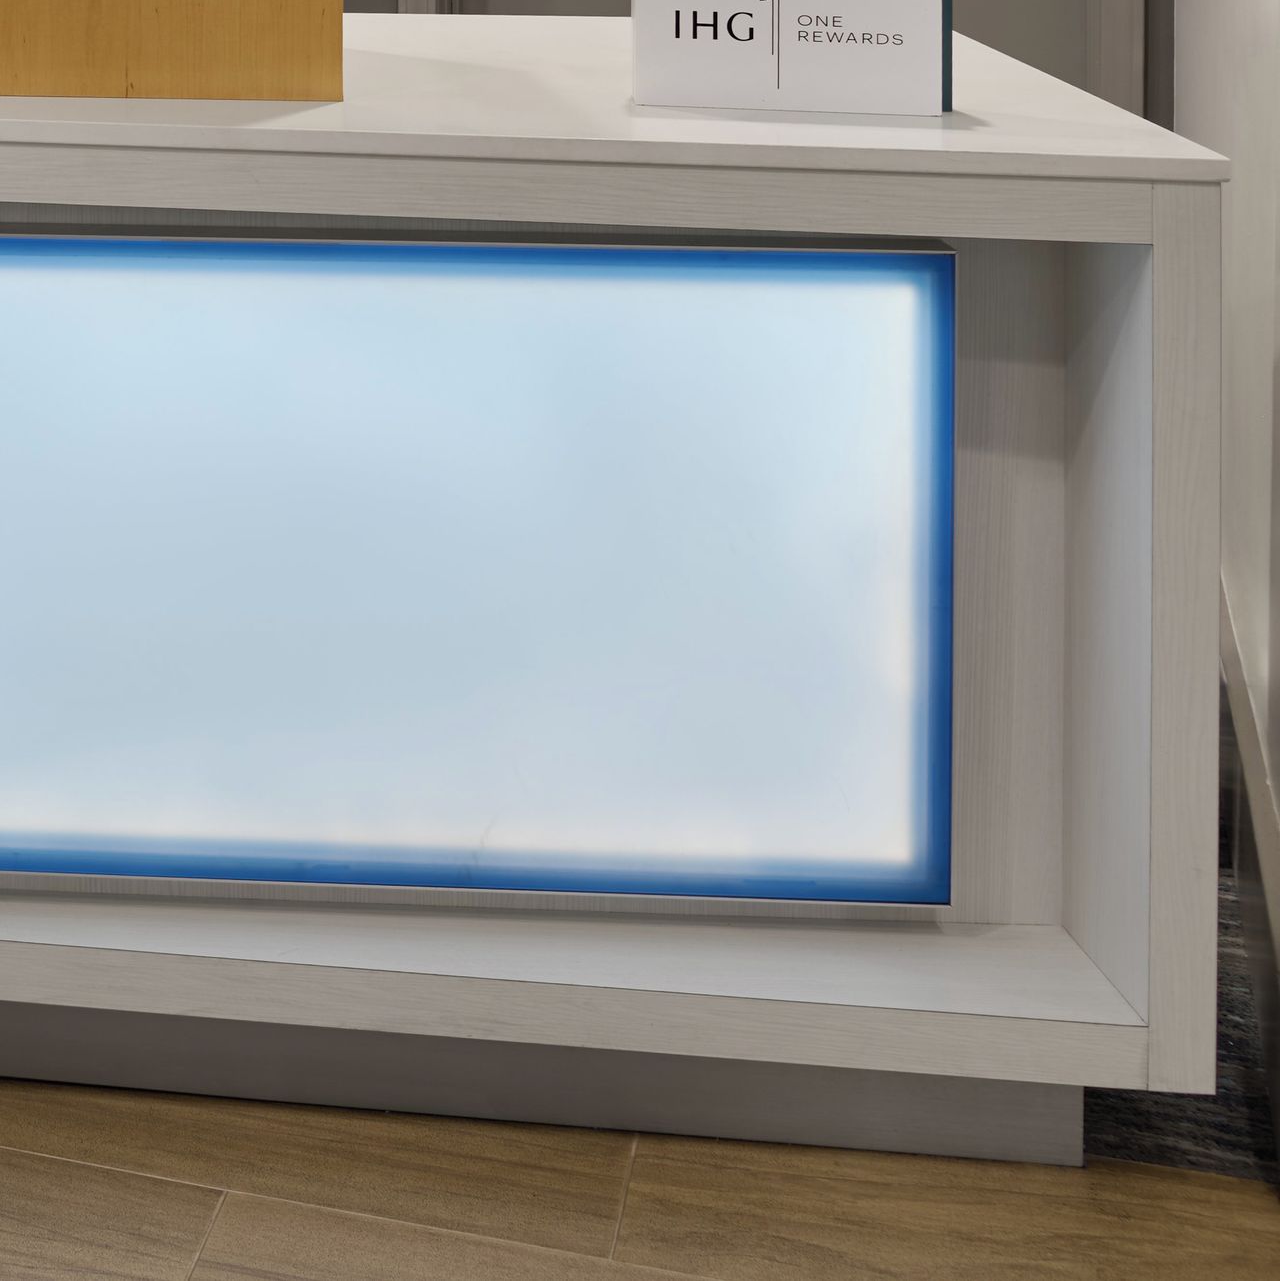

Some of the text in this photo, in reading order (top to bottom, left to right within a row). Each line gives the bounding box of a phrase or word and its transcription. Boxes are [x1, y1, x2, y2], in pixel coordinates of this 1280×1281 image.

[674, 9, 755, 42] IHG
[797, 15, 844, 28] ONE
[797, 30, 905, 46] REWARDS
